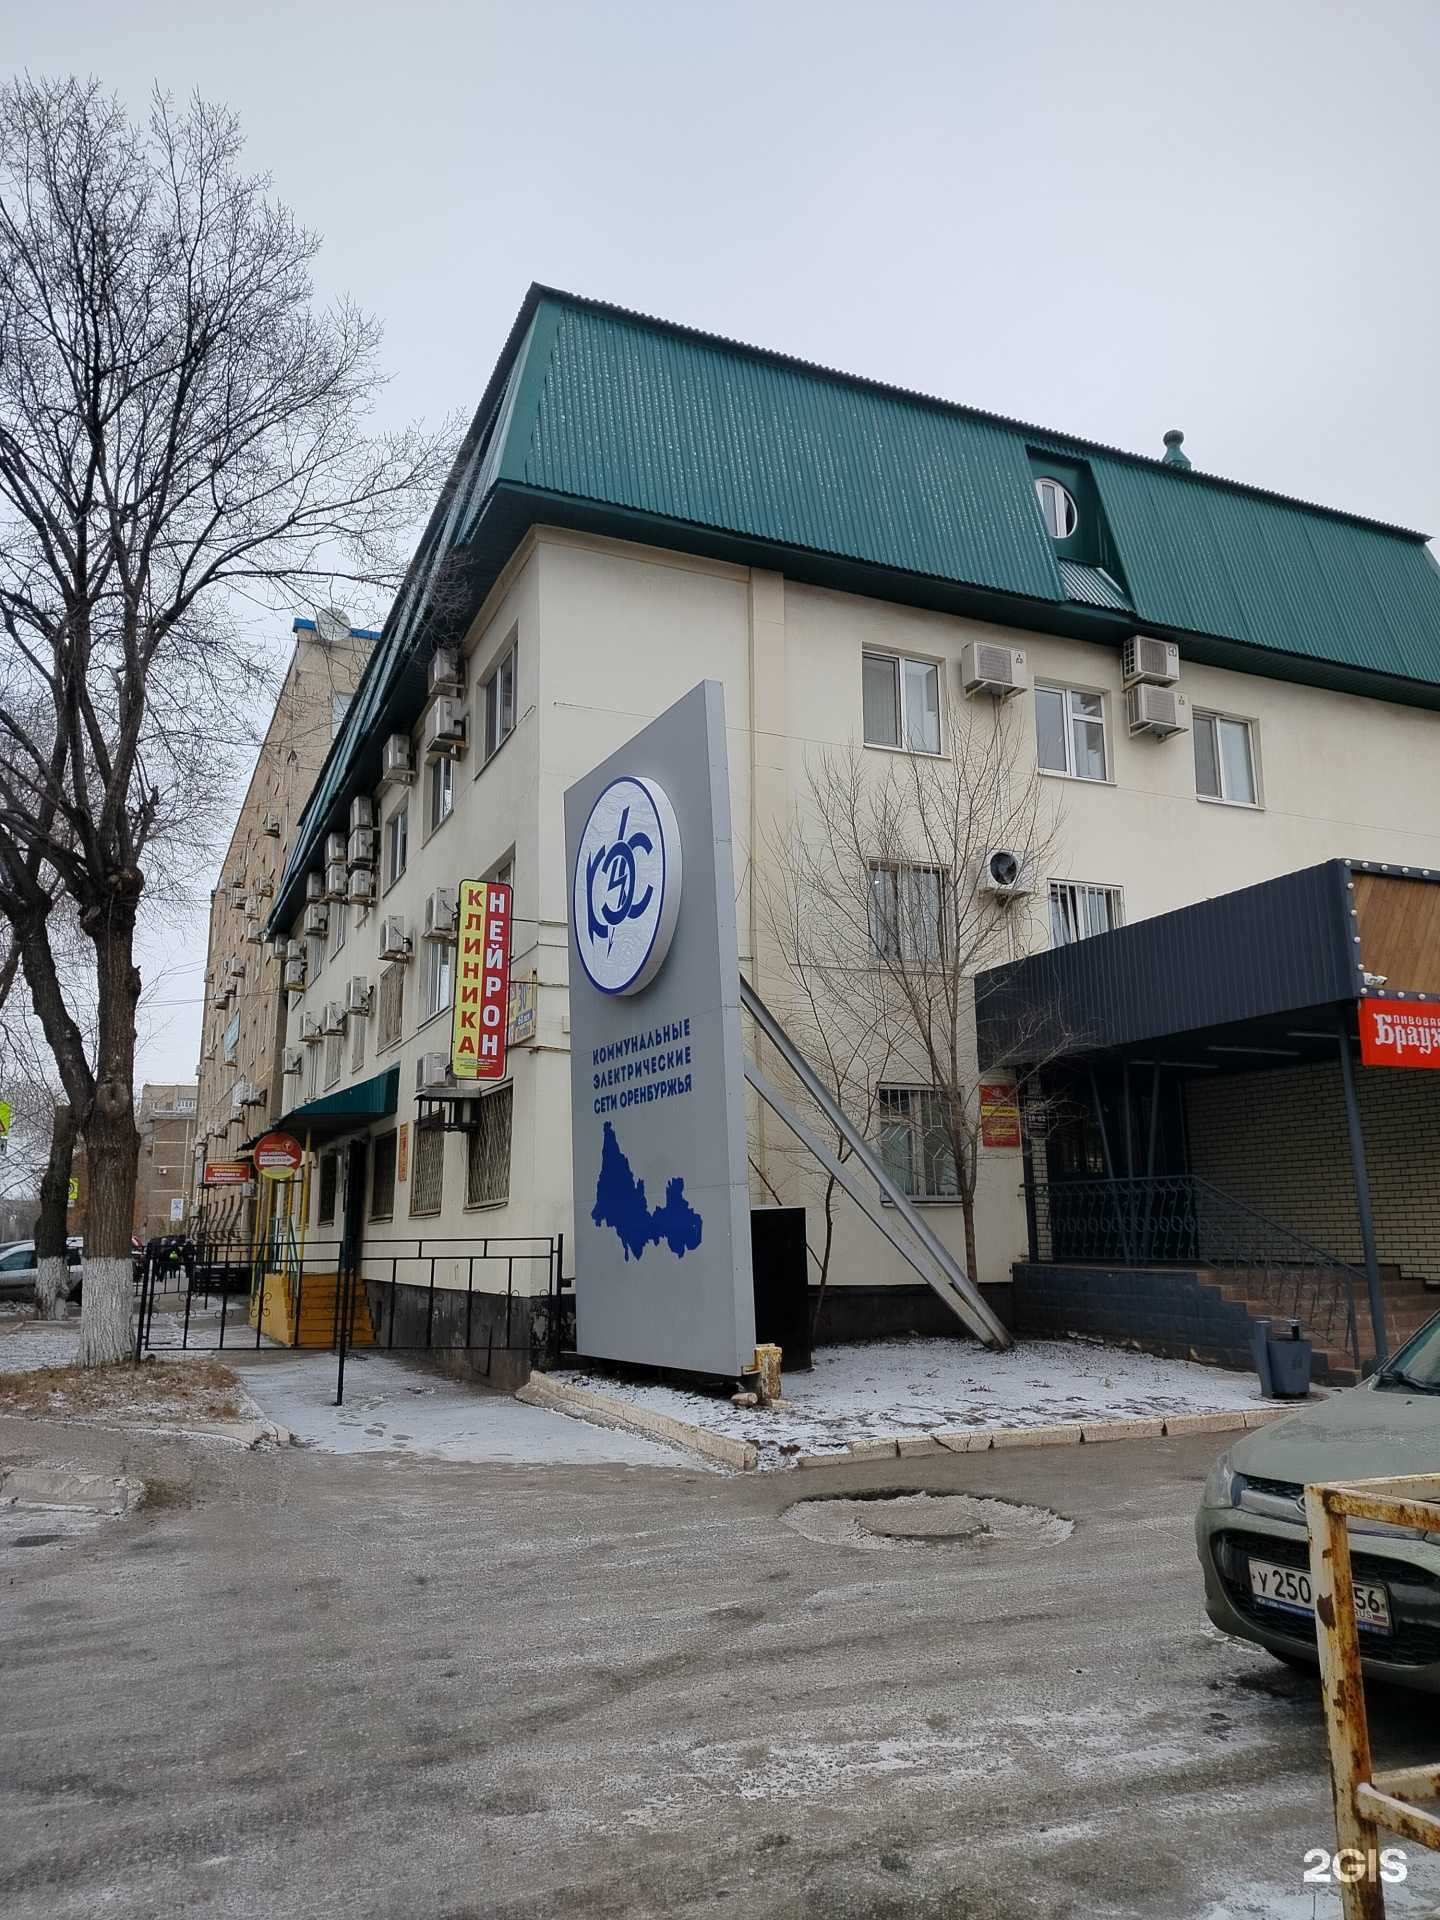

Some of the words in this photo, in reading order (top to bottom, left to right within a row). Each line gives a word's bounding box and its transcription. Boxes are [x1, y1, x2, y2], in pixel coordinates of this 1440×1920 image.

[458, 889, 484, 1053] КЛИНИКА
[481, 892, 505, 1056] НЕЙРОН
[592, 1018, 690, 1066] КОММУНАЛЬНЫЕ
[593, 1046, 691, 1090] ЭЛЕКТРИЧЕСКИЕ
[594, 1094, 617, 1114] СЕТИ
[619, 1074, 692, 1108] ОРЕНБУРЖЬЯ
[1354, 1587, 1380, 1613] 56
